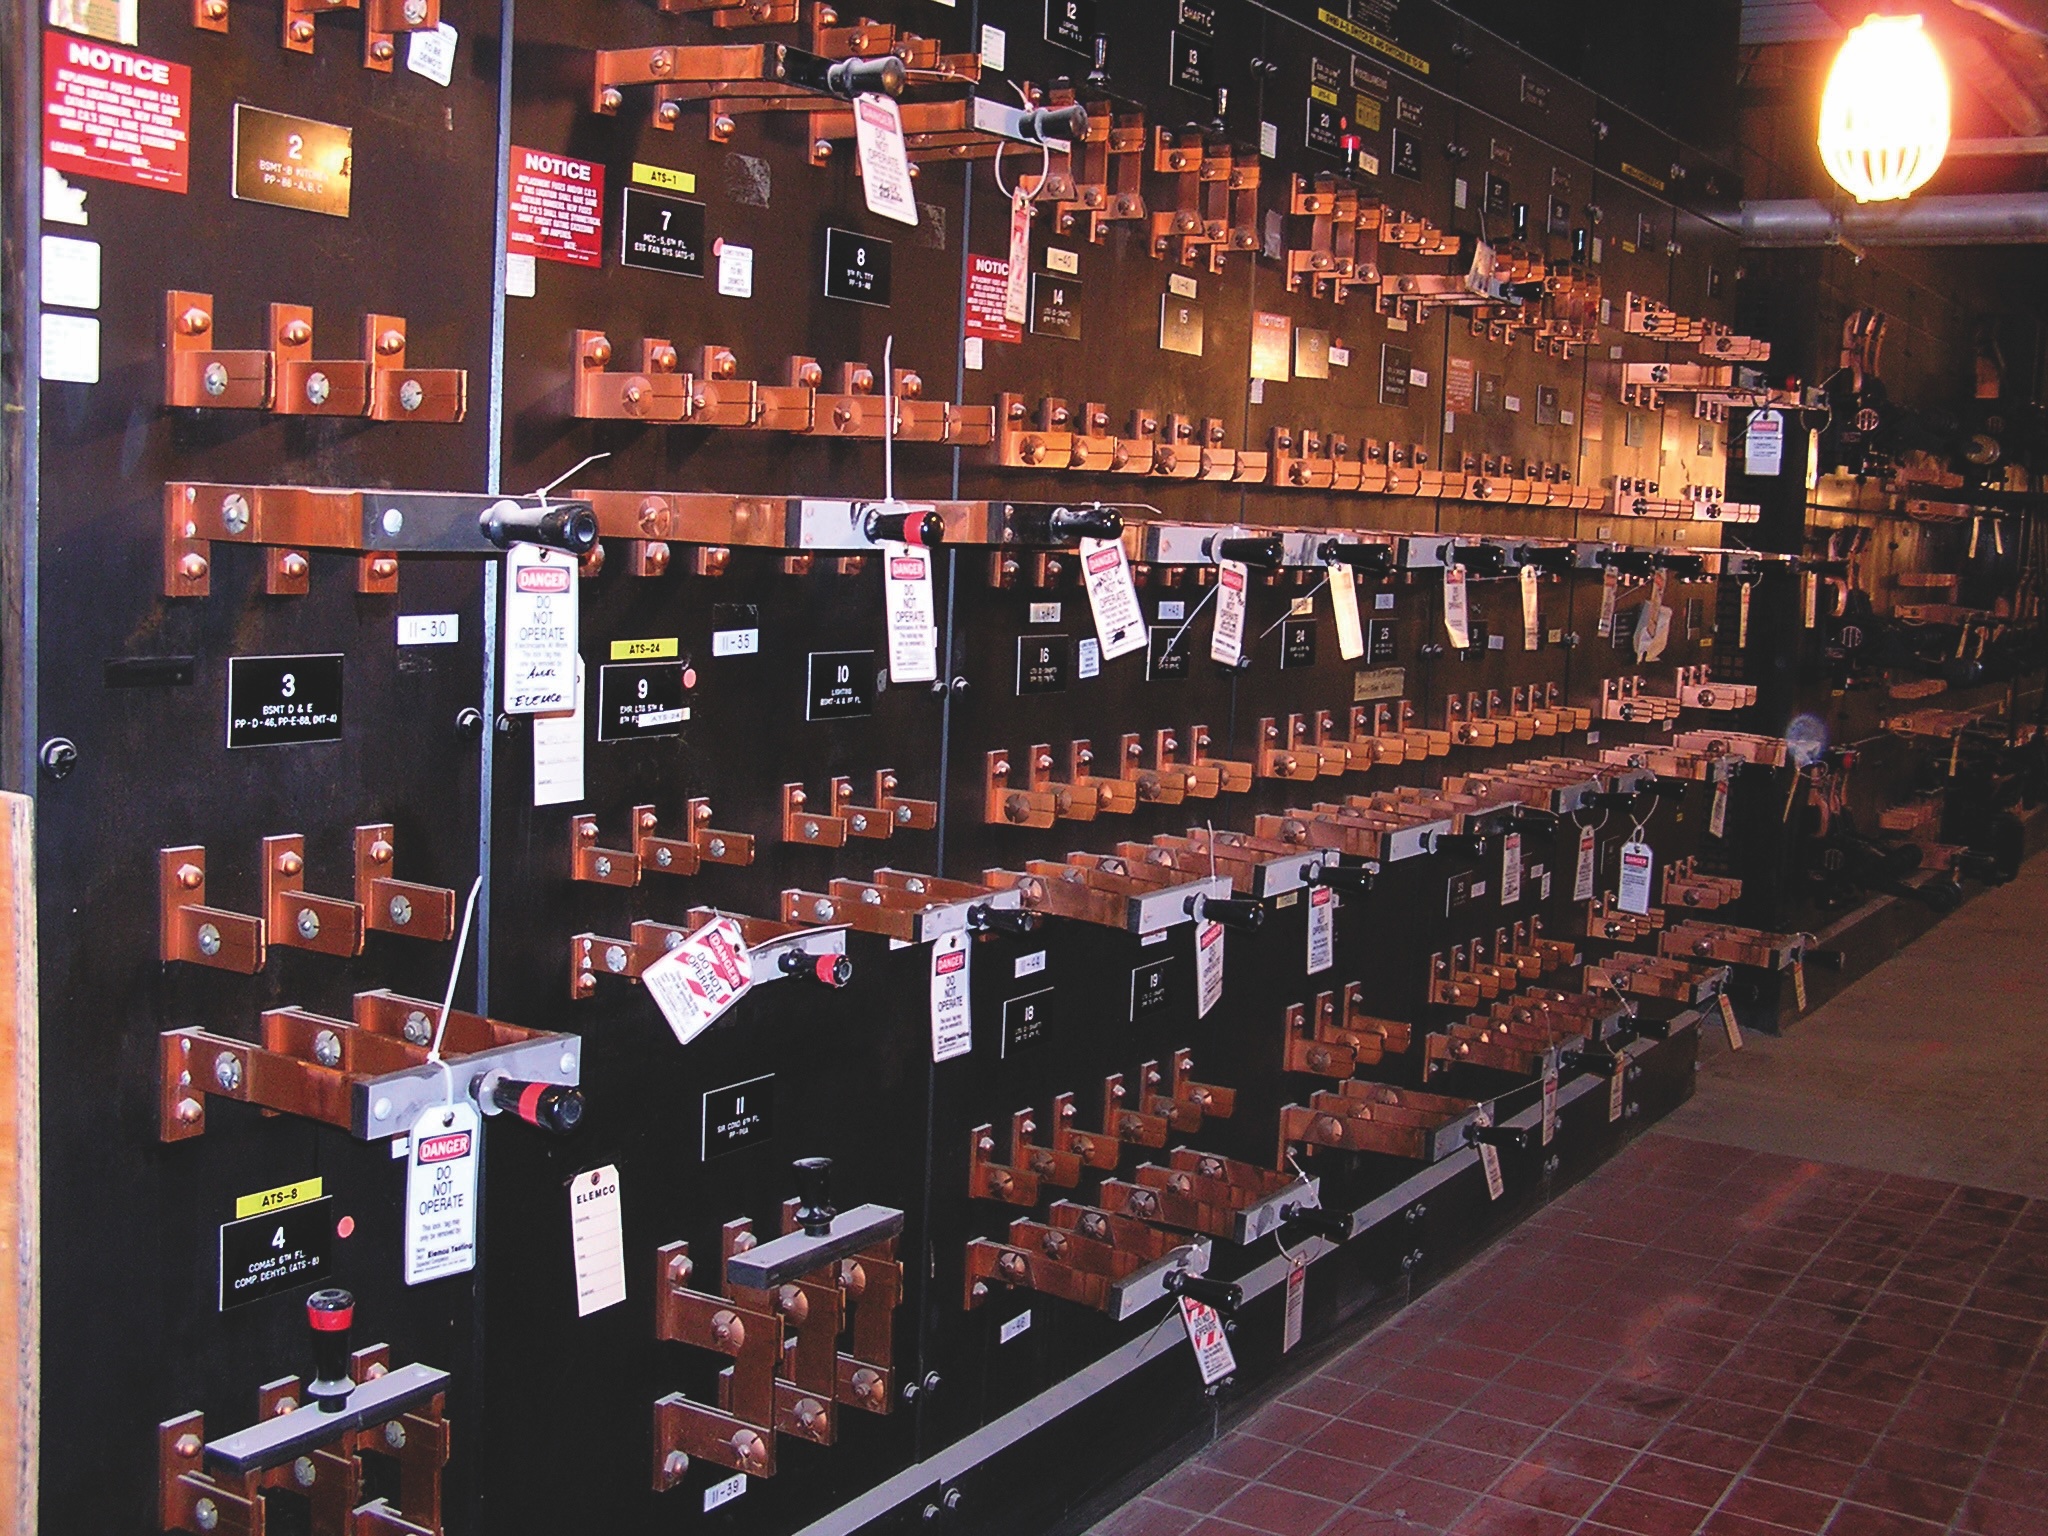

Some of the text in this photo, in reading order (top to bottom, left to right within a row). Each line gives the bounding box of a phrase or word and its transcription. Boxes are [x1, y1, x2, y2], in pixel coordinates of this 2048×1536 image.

[1067, 1, 1077, 19] 12
[1184, 6, 1206, 24] SHAFT
[69, 42, 170, 85] NOTICE
[1189, 49, 1198, 65] 13
[289, 134, 303, 160] 2
[525, 152, 591, 181] NOTICE
[651, 171, 677, 185] ATS-1
[661, 210, 672, 231] 7
[857, 248, 865, 266] 8
[976, 258, 1009, 275] NOTIC
[1053, 289, 1063, 306] 14
[894, 562, 924, 575] DANGER
[1091, 552, 1117, 568] DANGER
[521, 573, 567, 588] DANGER
[904, 584, 914, 596] DO
[536, 595, 551, 609] DO
[903, 597, 917, 609] NOT
[533, 612, 553, 625] NOT
[895, 611, 925, 623] OPERATE
[519, 627, 565, 641] OPERATE
[629, 643, 660, 655] ATS-24
[1040, 648, 1050, 663] 16
[837, 665, 850, 683] 10
[282, 673, 296, 697] 3
[637, 678, 648, 699] 9
[262, 703, 313, 715] BSMT D & E
[709, 931, 741, 989] DANGER
[688, 955, 717, 1003] OPERATE
[697, 952, 723, 992] DO NOT
[937, 996, 963, 1012] OPERATE
[1025, 1005, 1034, 1021] 18
[422, 1139, 468, 1158] DANGER
[436, 1165, 452, 1181] DO
[433, 1180, 454, 1197] NOT
[577, 1184, 616, 1204] ELEMCO
[261, 1188, 298, 1207] ATS-8
[419, 1193, 464, 1215] OPERATE
[272, 1226, 286, 1249] 4
